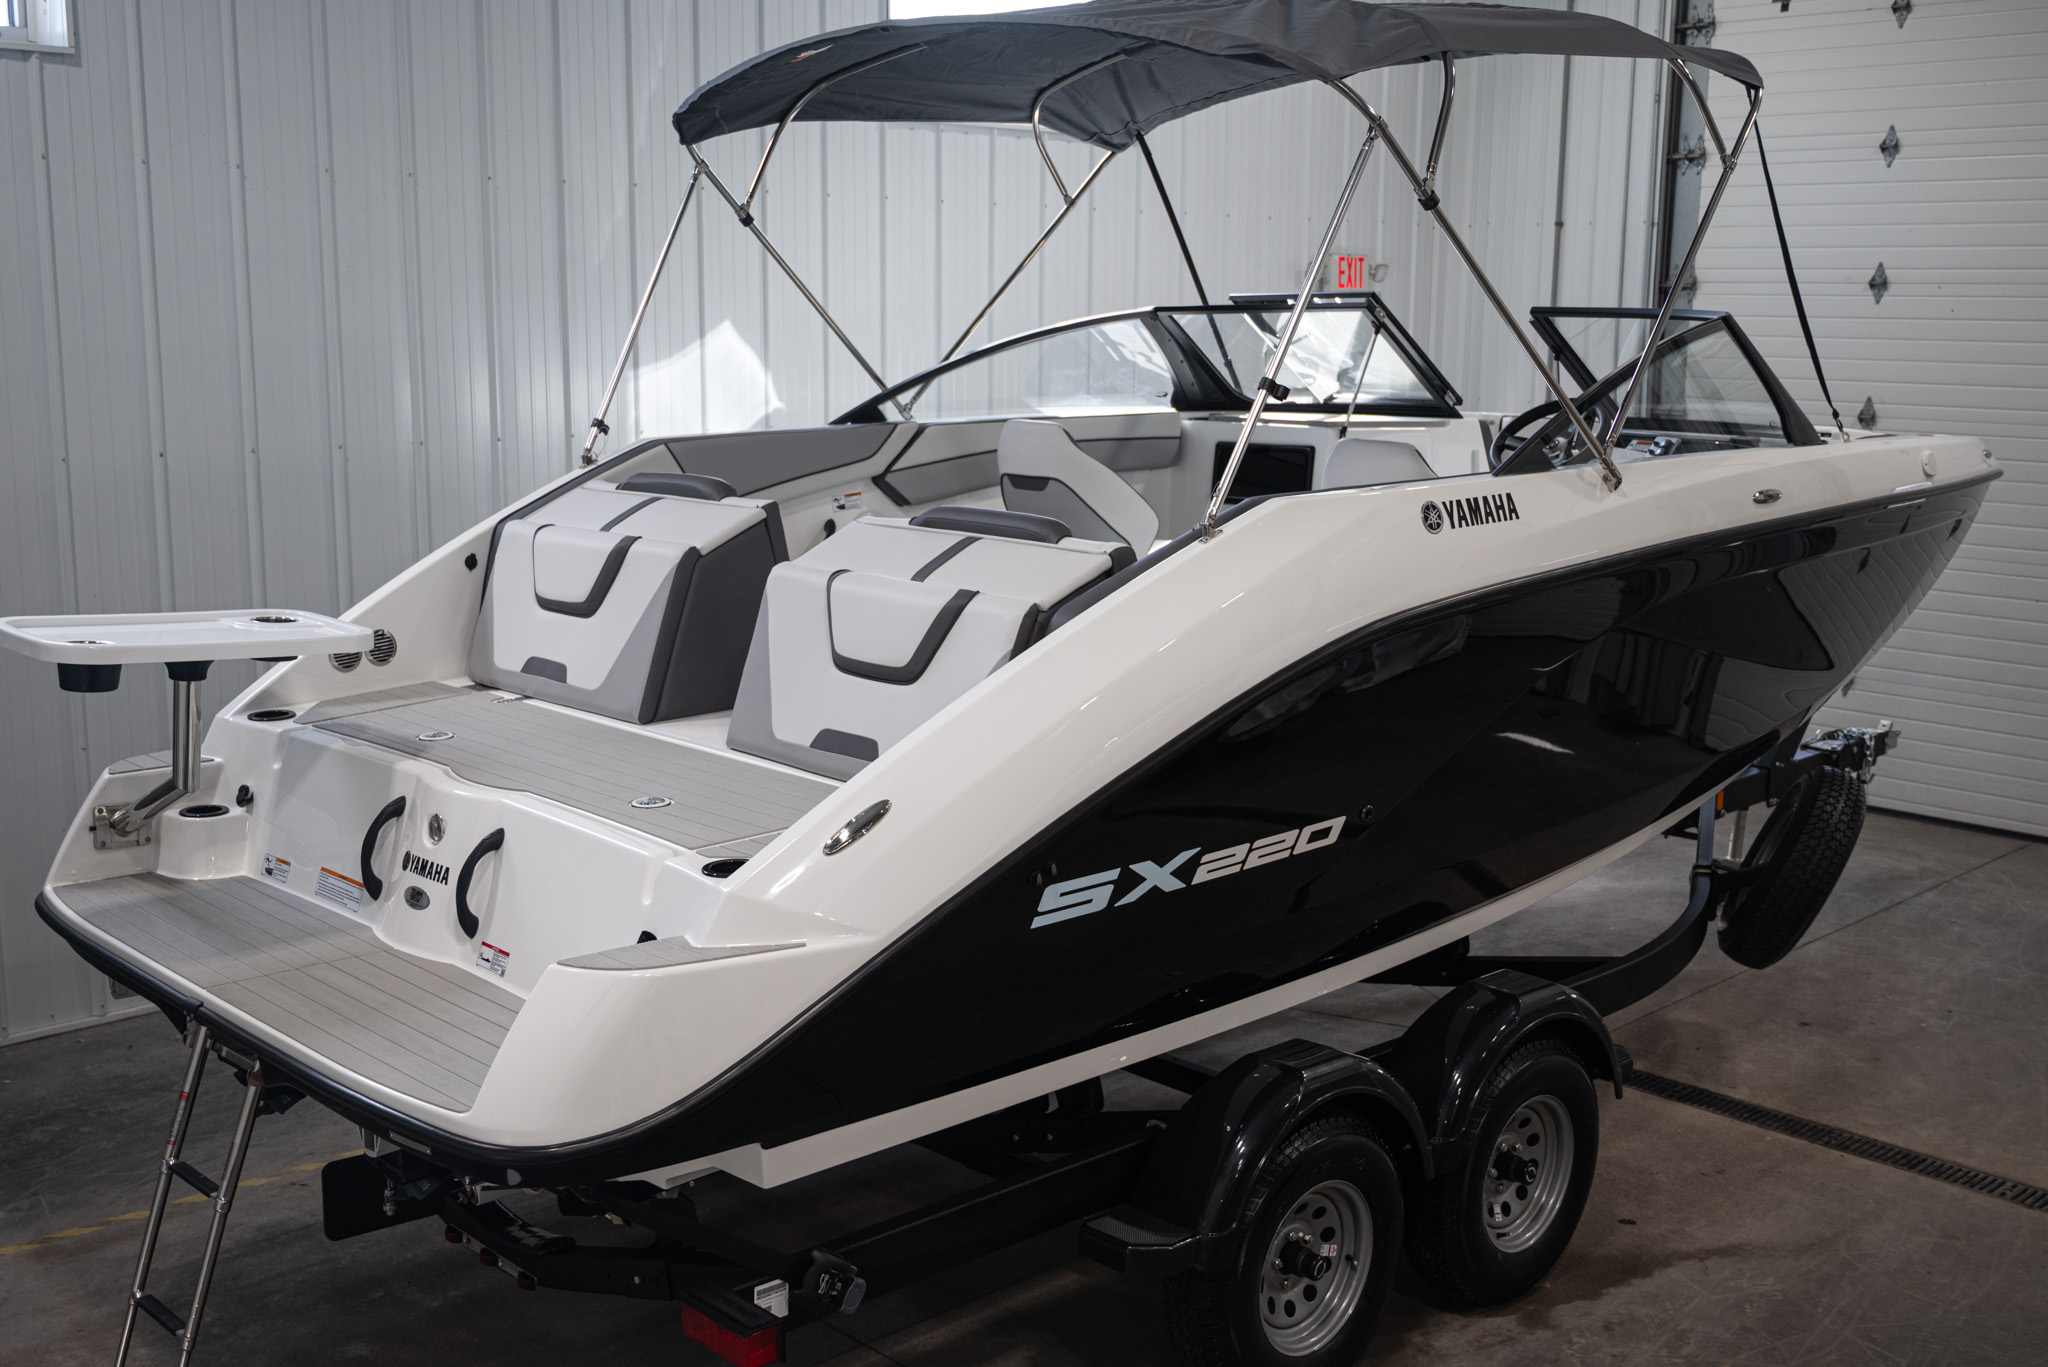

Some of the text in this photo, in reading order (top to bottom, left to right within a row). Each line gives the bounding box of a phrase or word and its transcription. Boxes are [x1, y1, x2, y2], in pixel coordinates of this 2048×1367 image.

[1338, 256, 1365, 289] EXIT
[1441, 492, 1521, 530] YAMAHA
[409, 853, 451, 886] YAMAHA
[1030, 815, 1347, 930] SX220
